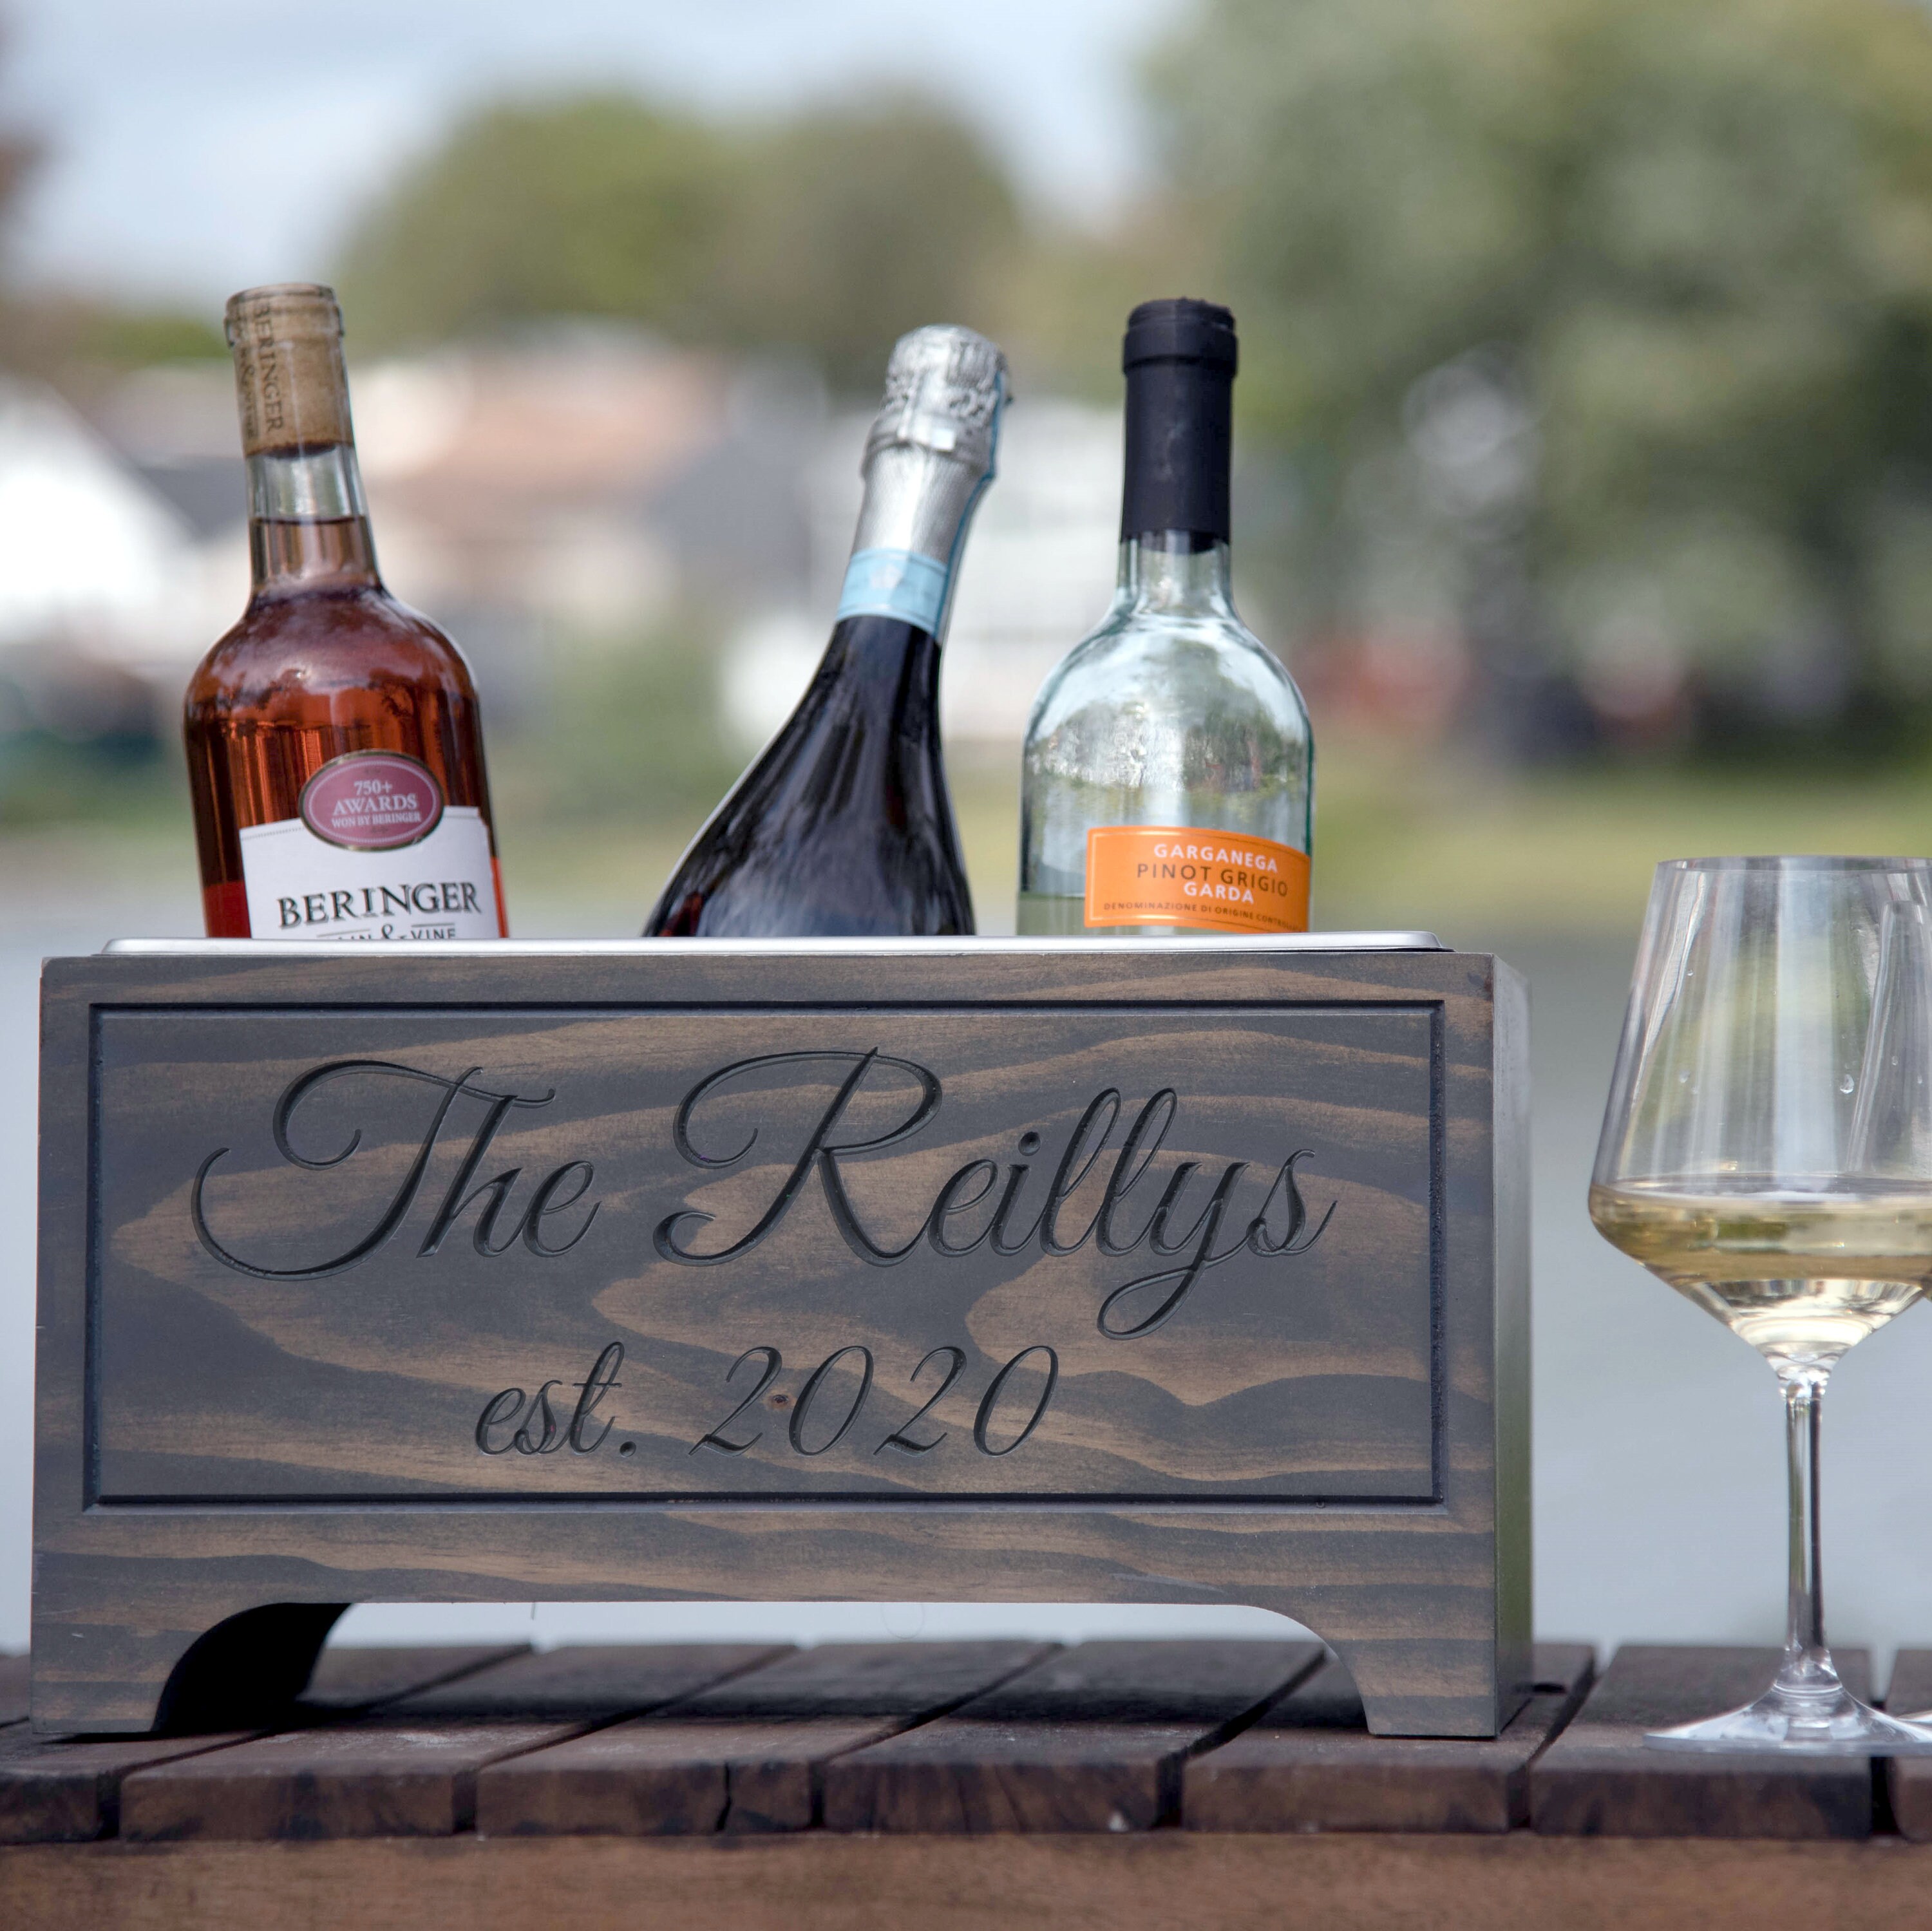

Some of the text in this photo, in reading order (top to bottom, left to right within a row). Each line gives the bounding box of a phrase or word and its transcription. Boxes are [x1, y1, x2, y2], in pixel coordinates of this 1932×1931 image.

[354, 779, 393, 795] 750+
[332, 793, 417, 816] AWARDS
[331, 811, 421, 828] WON BY BERINGER
[1154, 844, 1278, 872] GARGANEGA
[1137, 863, 1287, 897] PINOT GRIGIO
[1184, 881, 1254, 905] GARDA
[277, 882, 482, 930] BERINGER
[1104, 902, 1197, 912] DENOMINAZIONE
[1215, 907, 1253, 919] ORIGINE
[191, 1046, 1337, 1341] The Reillys
[475, 1342, 1059, 1458] est. 2020
